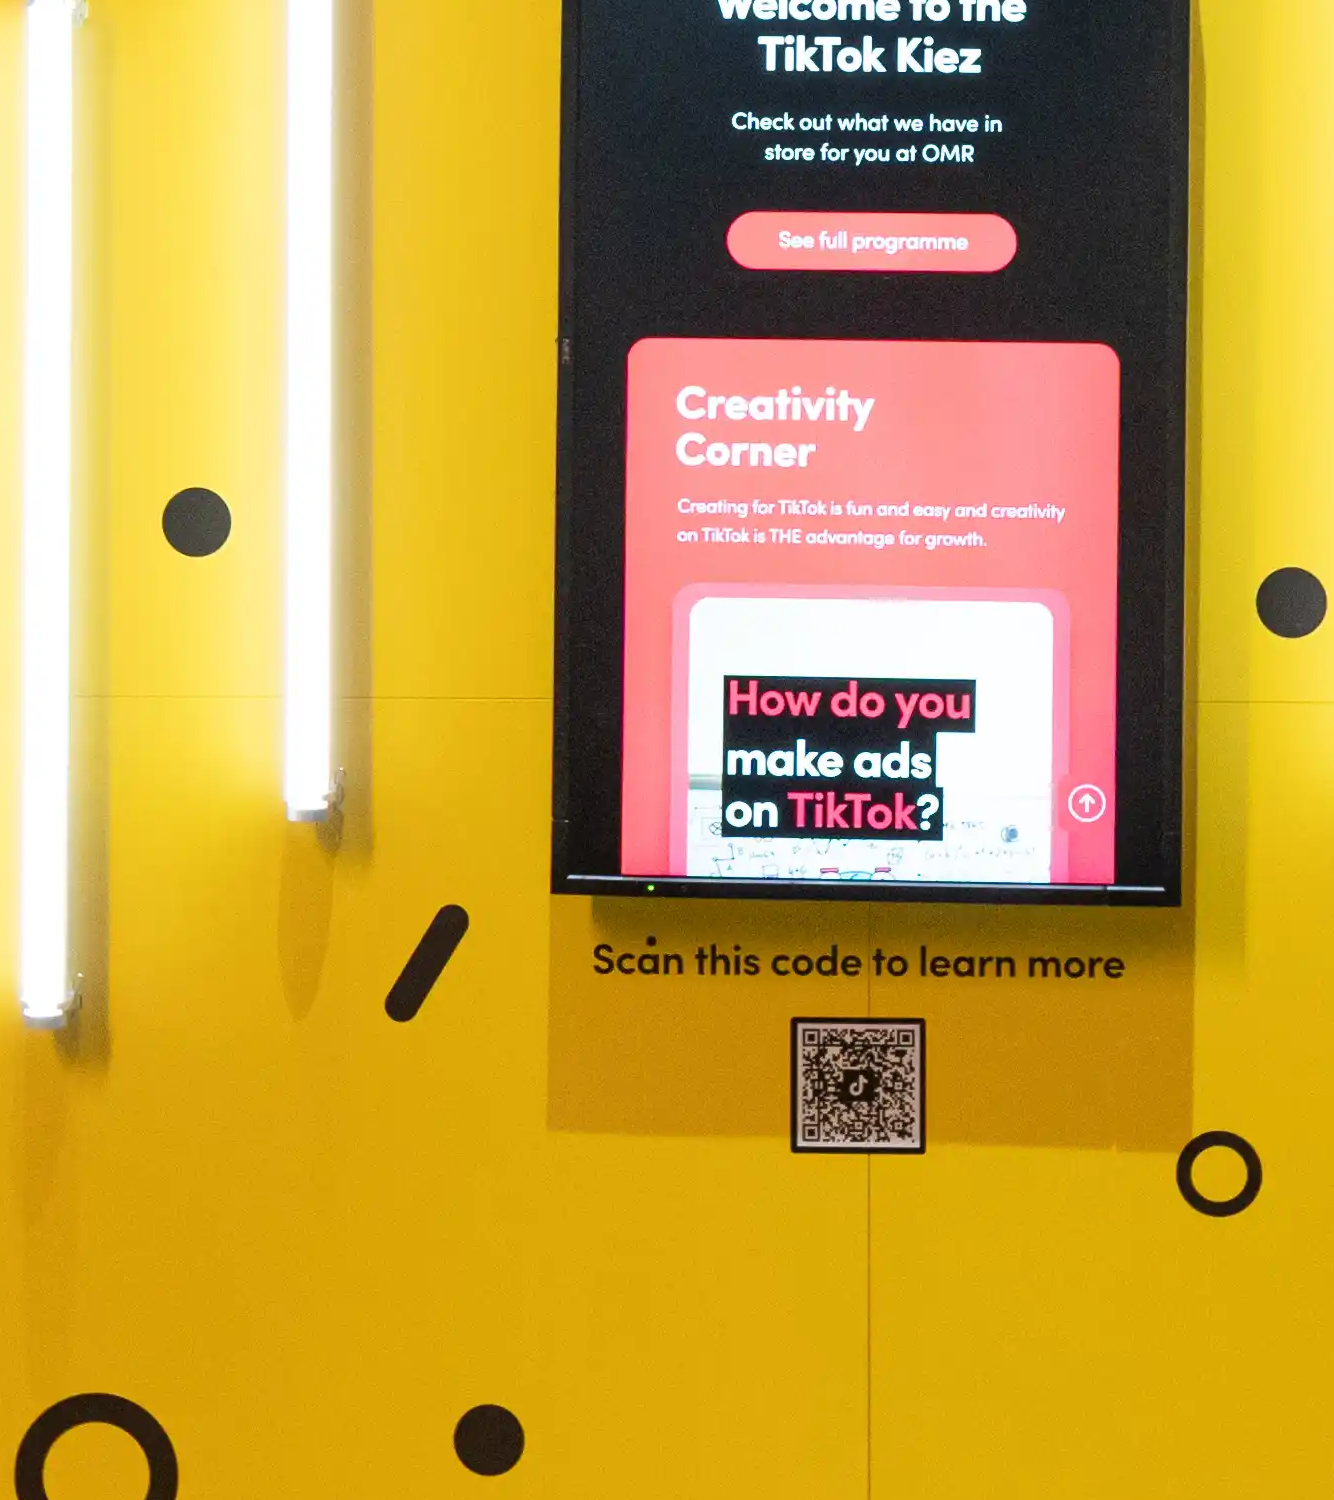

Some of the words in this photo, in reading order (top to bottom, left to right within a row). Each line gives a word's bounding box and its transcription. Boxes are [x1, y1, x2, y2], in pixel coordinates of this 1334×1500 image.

[758, 35, 887, 72] TikTok
[898, 36, 981, 73] Kiez
[732, 112, 795, 130] Check
[799, 114, 832, 130] out
[837, 113, 889, 131] what
[894, 119, 923, 131] we
[930, 114, 978, 132] have
[985, 115, 1002, 132] in
[765, 144, 815, 161] store
[820, 143, 849, 161] for
[854, 149, 890, 166] you
[896, 145, 917, 161] at
[922, 144, 974, 162] OMR
[779, 231, 814, 249] See
[819, 231, 847, 249] full
[852, 236, 968, 254] programme
[676, 386, 875, 431] Creativity
[676, 433, 816, 468] Corner
[677, 498, 748, 518] Creating
[752, 499, 775, 514] for
[778, 500, 827, 515] TikTok
[830, 501, 843, 515] is
[846, 500, 873, 516] fun
[876, 501, 909, 516] and
[913, 506, 951, 521] easy
[955, 503, 987, 517] and
[991, 504, 1065, 522] creativity
[677, 531, 698, 542] on
[701, 527, 750, 542] TikTok
[754, 529, 766, 543] is
[769, 528, 802, 543] THE
[805, 529, 895, 549] advantage
[899, 530, 923, 545] for
[925, 532, 987, 550] growth.
[729, 680, 822, 716] How
[831, 680, 885, 718] do
[895, 691, 971, 729] you
[728, 739, 843, 777] make
[854, 741, 932, 779] ads
[726, 801, 778, 827] on
[787, 792, 939, 831] TikTok?
[593, 943, 683, 975] Scan
[695, 943, 759, 975] this
[771, 944, 862, 976] code
[872, 948, 908, 976] to
[920, 945, 1015, 977] learn
[1029, 956, 1125, 978] more
